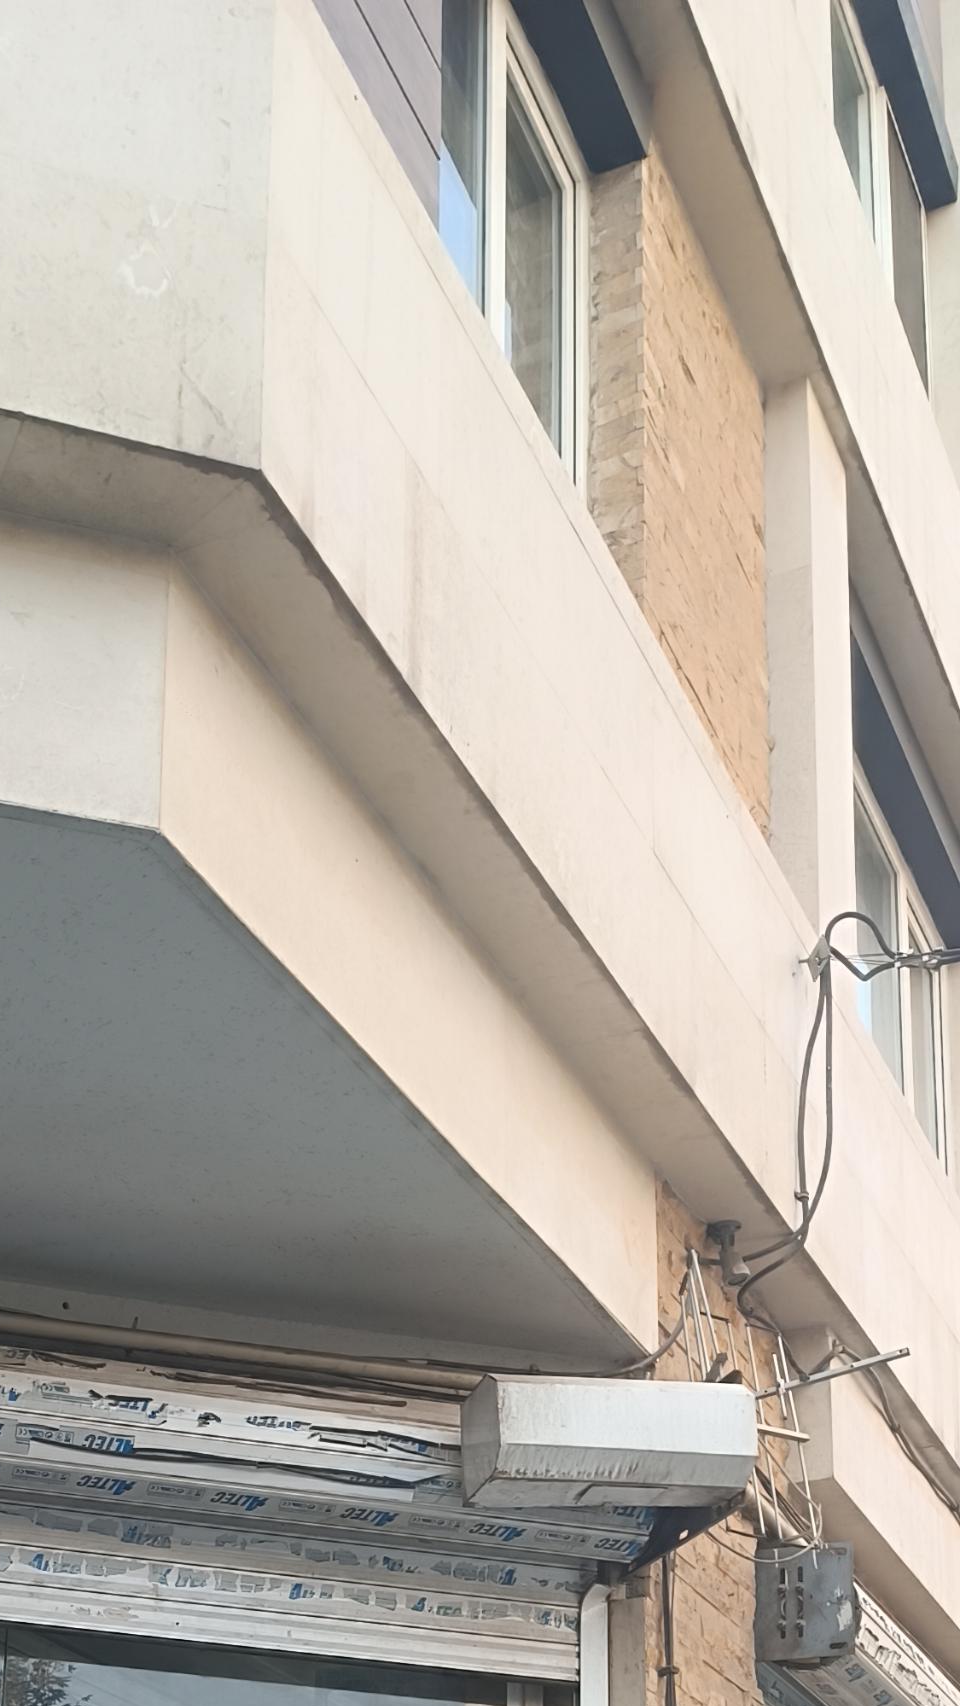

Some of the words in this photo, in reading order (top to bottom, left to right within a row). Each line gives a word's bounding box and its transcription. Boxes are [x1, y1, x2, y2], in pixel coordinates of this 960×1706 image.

[76, 1474, 136, 1496] ALTEC
[210, 1491, 271, 1512] ALTEC
[341, 1506, 399, 1527] ALTEC
[469, 1522, 528, 1543] ALTEC
